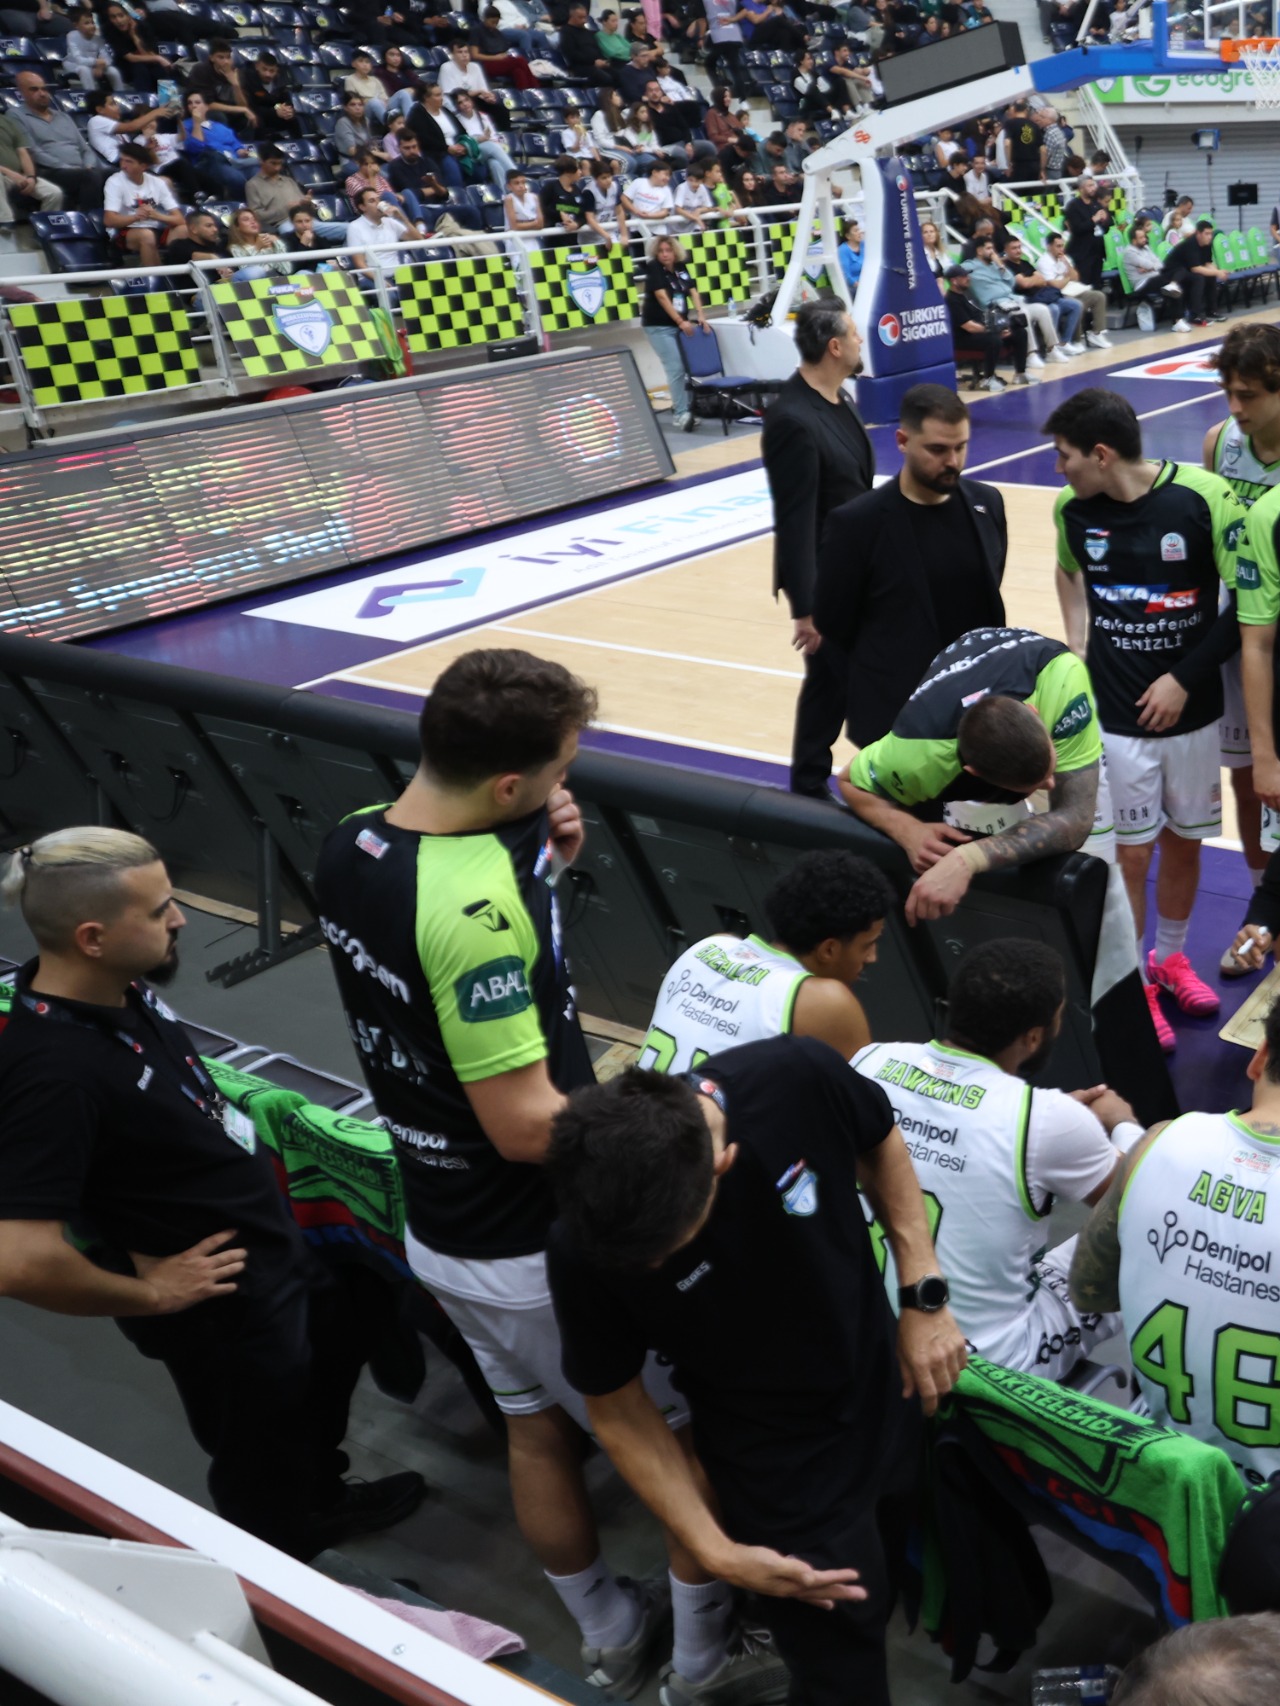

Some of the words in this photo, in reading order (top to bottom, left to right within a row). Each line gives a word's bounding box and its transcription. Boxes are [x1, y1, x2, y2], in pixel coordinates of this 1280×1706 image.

[676, 998, 743, 1038] Hastanesi
[873, 1057, 987, 1110] HAWKINS
[904, 1141, 968, 1174] stanesi
[1187, 1169, 1267, 1225] AĞVA
[1190, 1229, 1272, 1274] Denipol
[676, 1260, 712, 1292] GEGES
